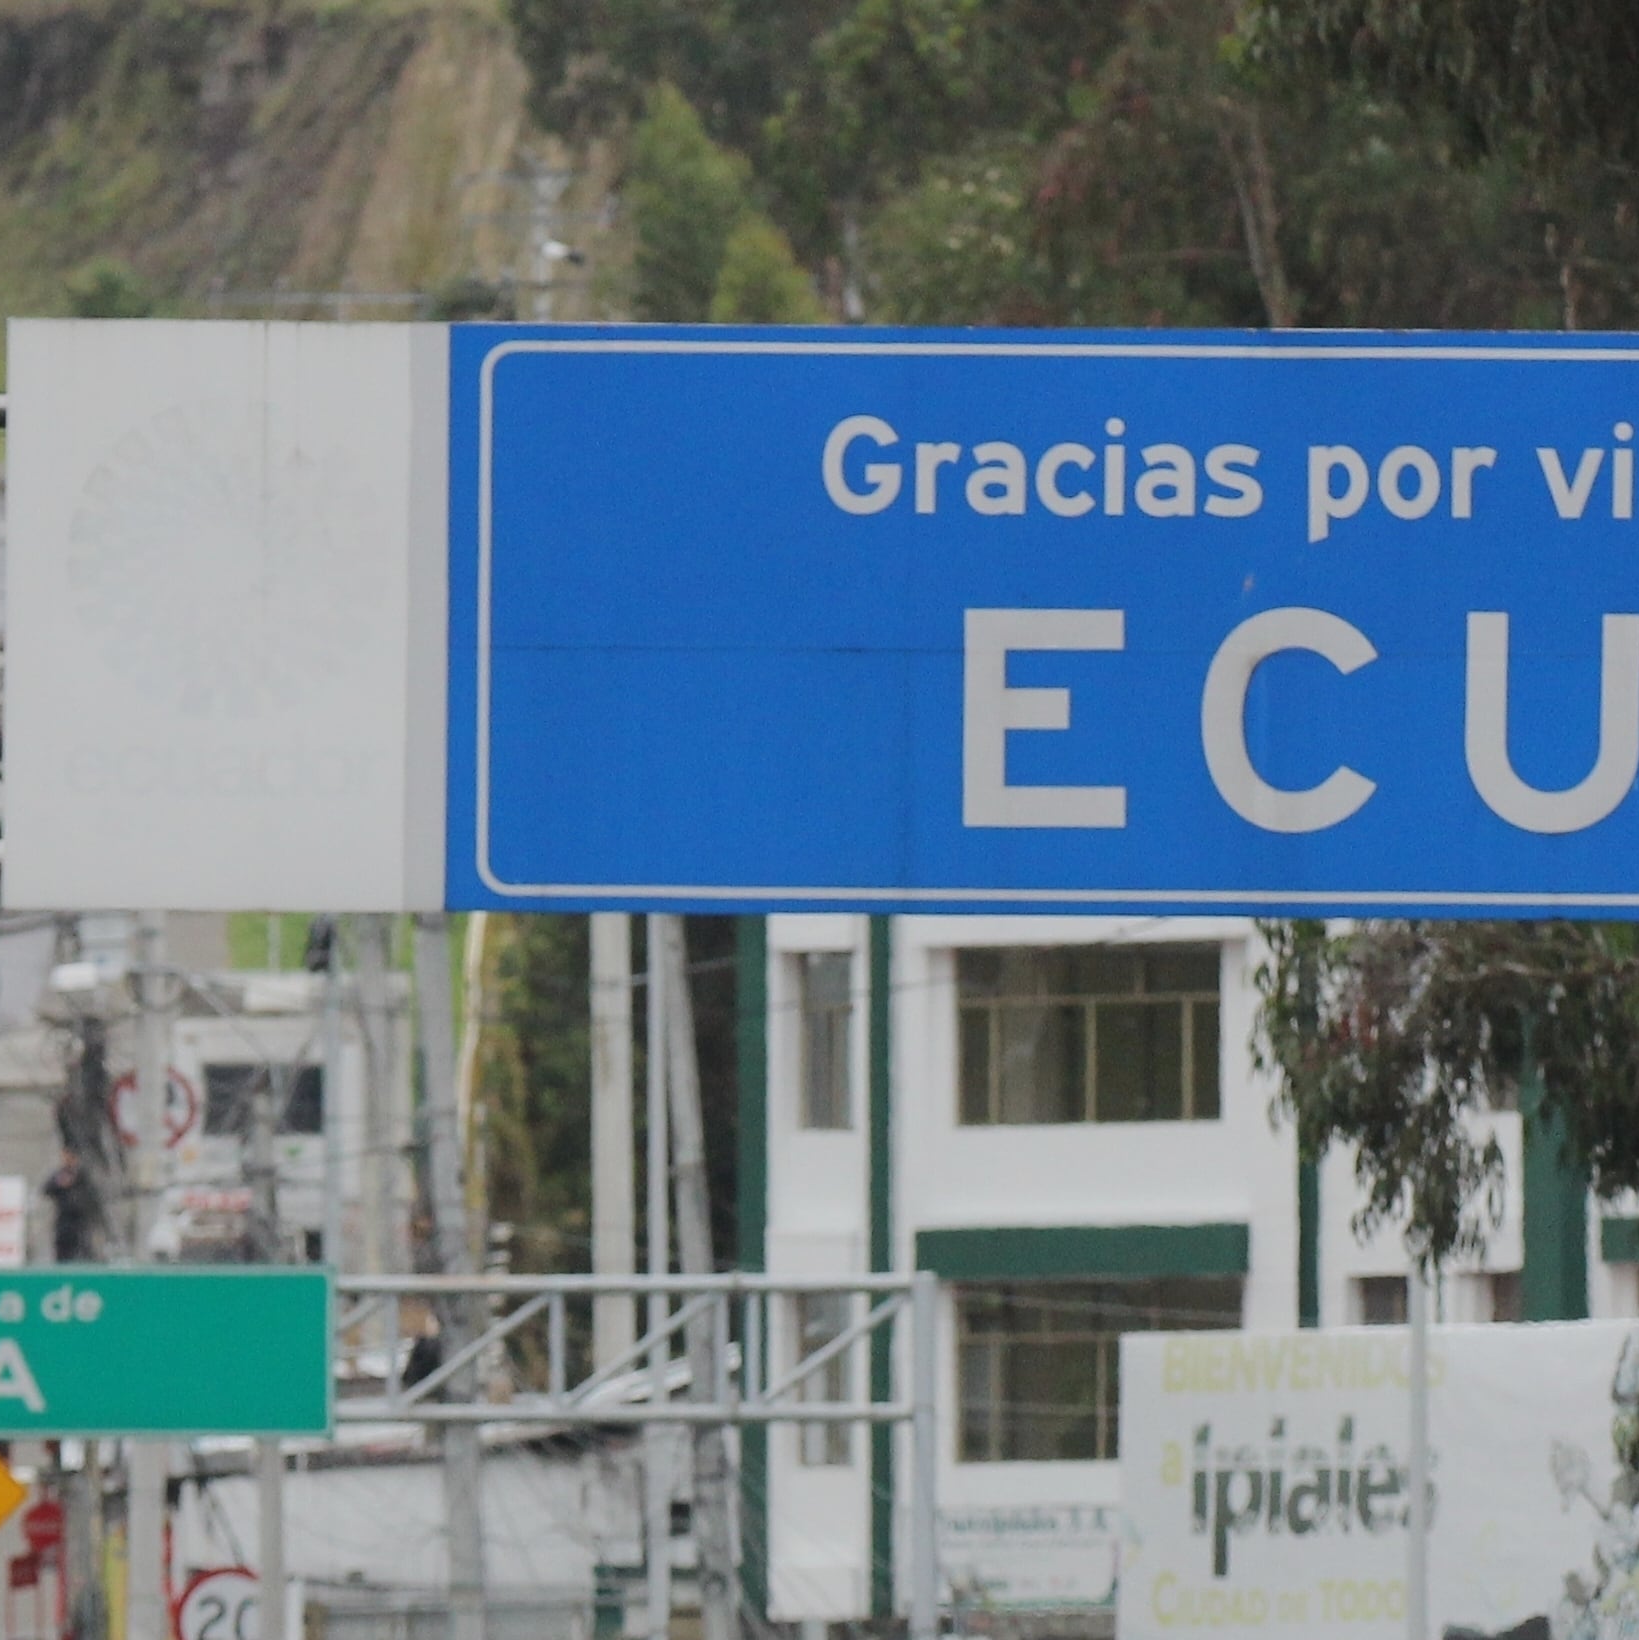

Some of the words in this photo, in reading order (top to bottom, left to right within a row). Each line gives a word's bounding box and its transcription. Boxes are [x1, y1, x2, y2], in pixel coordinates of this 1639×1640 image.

[822, 415, 1264, 519] Gracias
[1308, 444, 1497, 543] por
[41, 1286, 103, 1323] de
